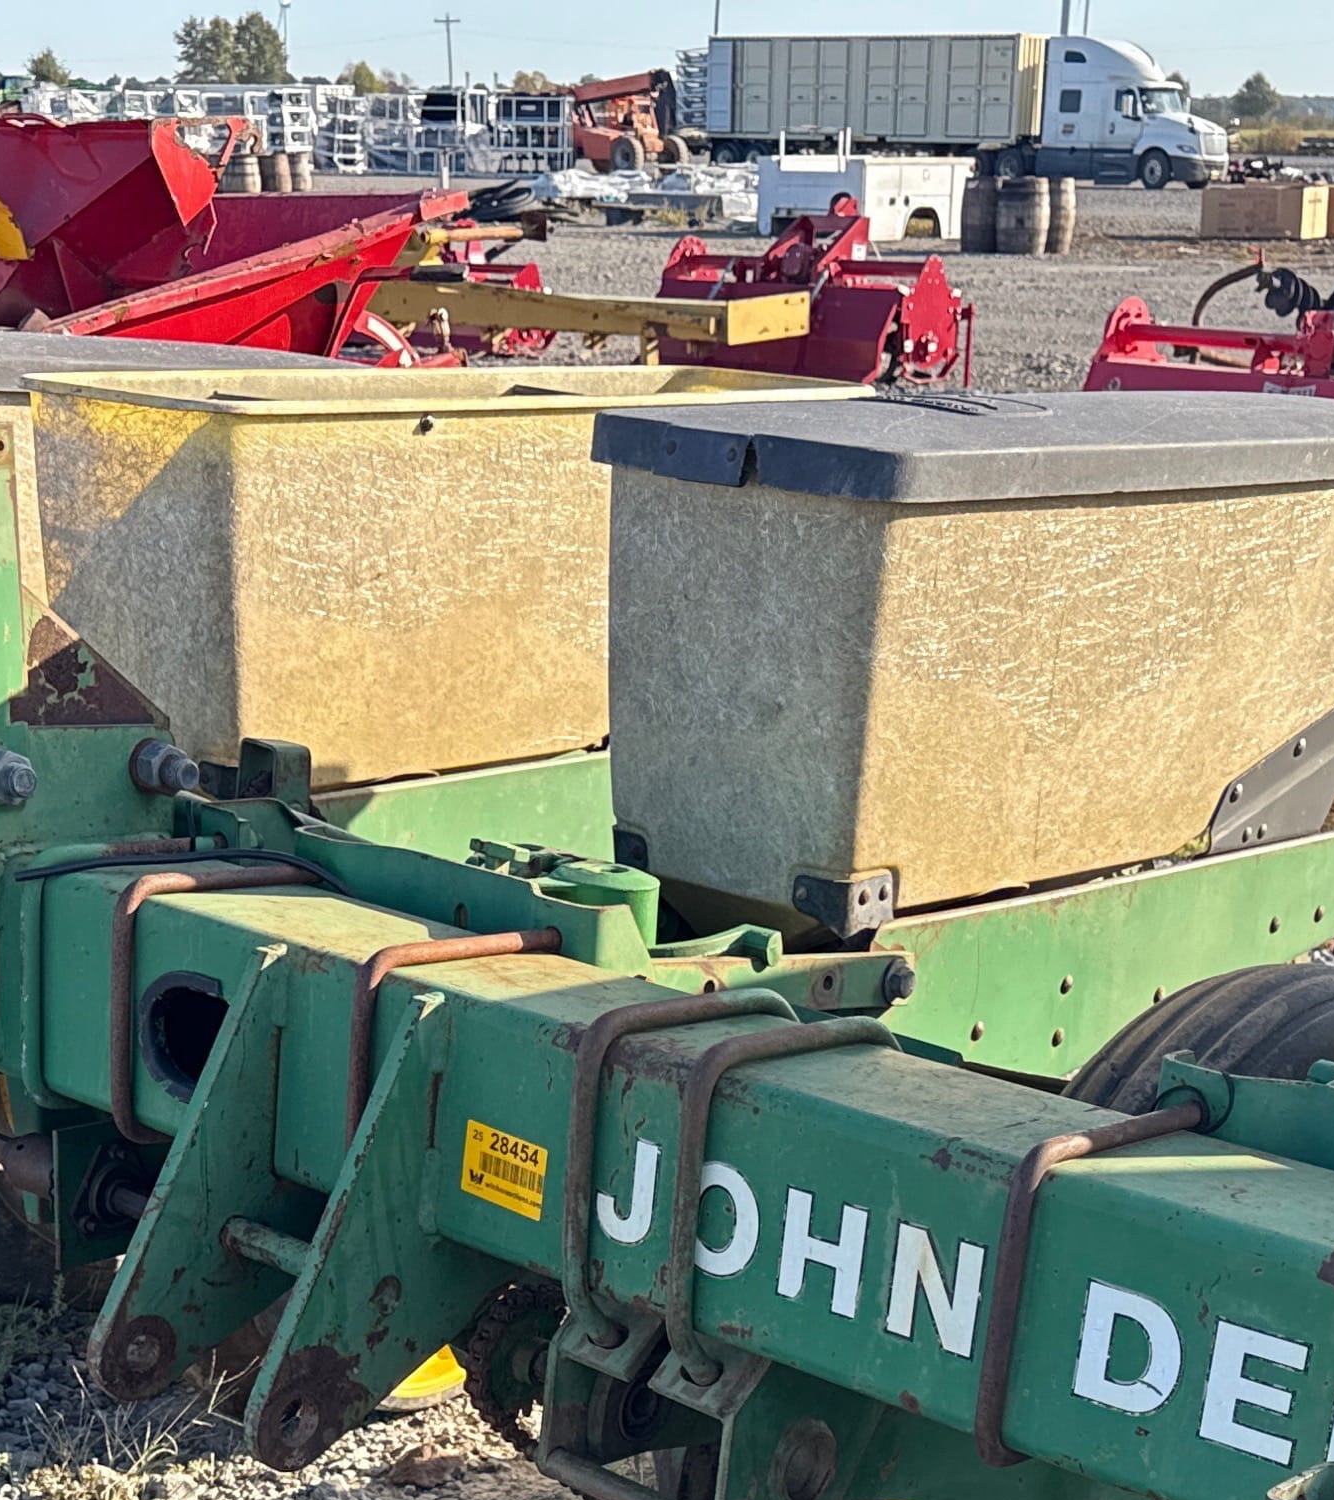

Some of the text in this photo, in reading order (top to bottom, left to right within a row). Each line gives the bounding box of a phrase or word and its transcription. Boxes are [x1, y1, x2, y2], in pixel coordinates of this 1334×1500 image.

[472, 1129, 540, 1167] 25 28454
[596, 1137, 988, 1359] JOHN
